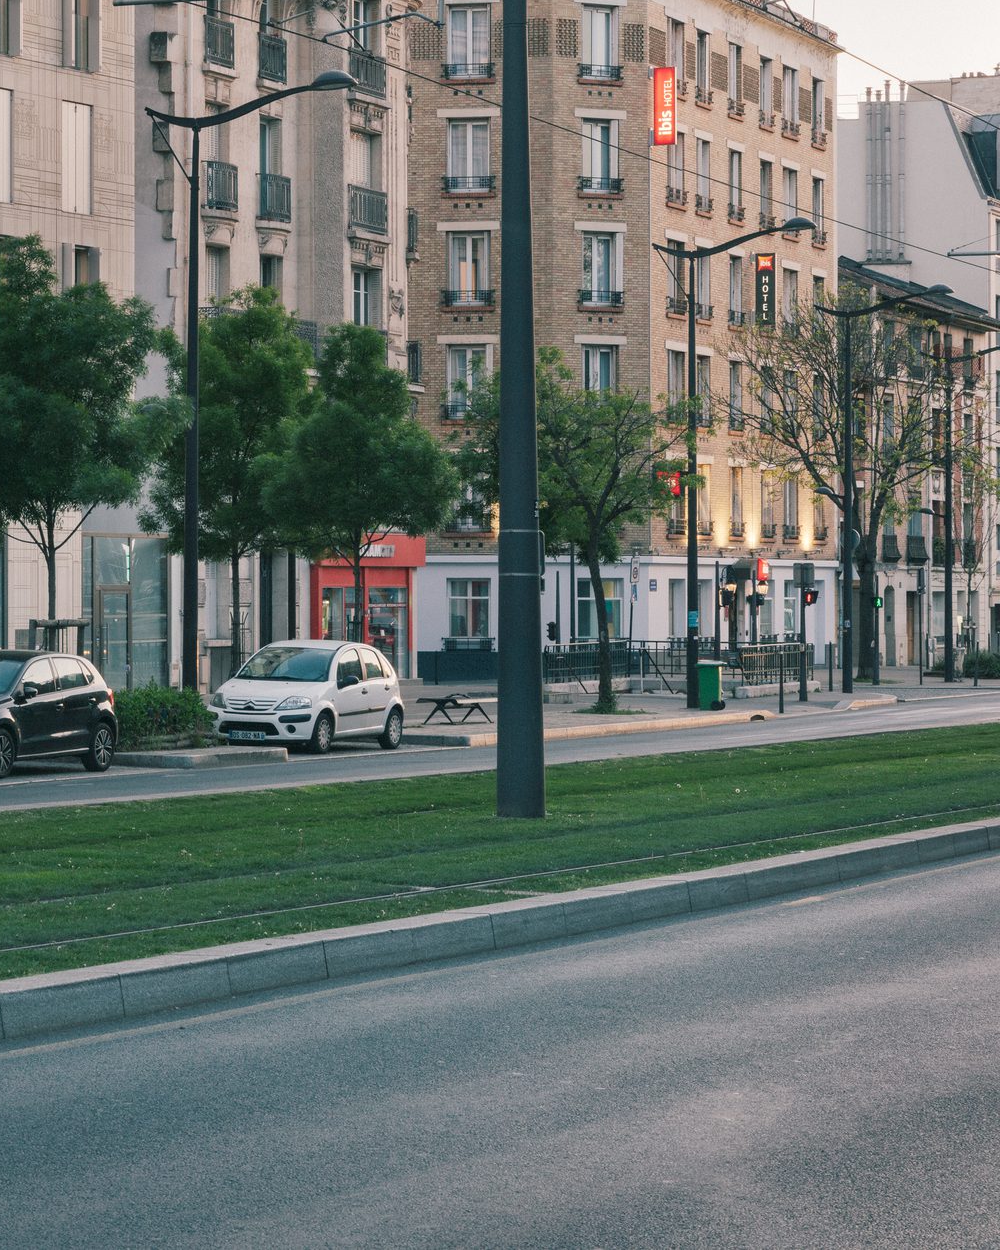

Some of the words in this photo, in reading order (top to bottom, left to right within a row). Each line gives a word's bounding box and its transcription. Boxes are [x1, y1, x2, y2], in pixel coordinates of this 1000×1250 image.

[663, 78, 672, 107] HOTEL
[658, 110, 672, 135] ibis
[760, 259, 771, 267] ibis
